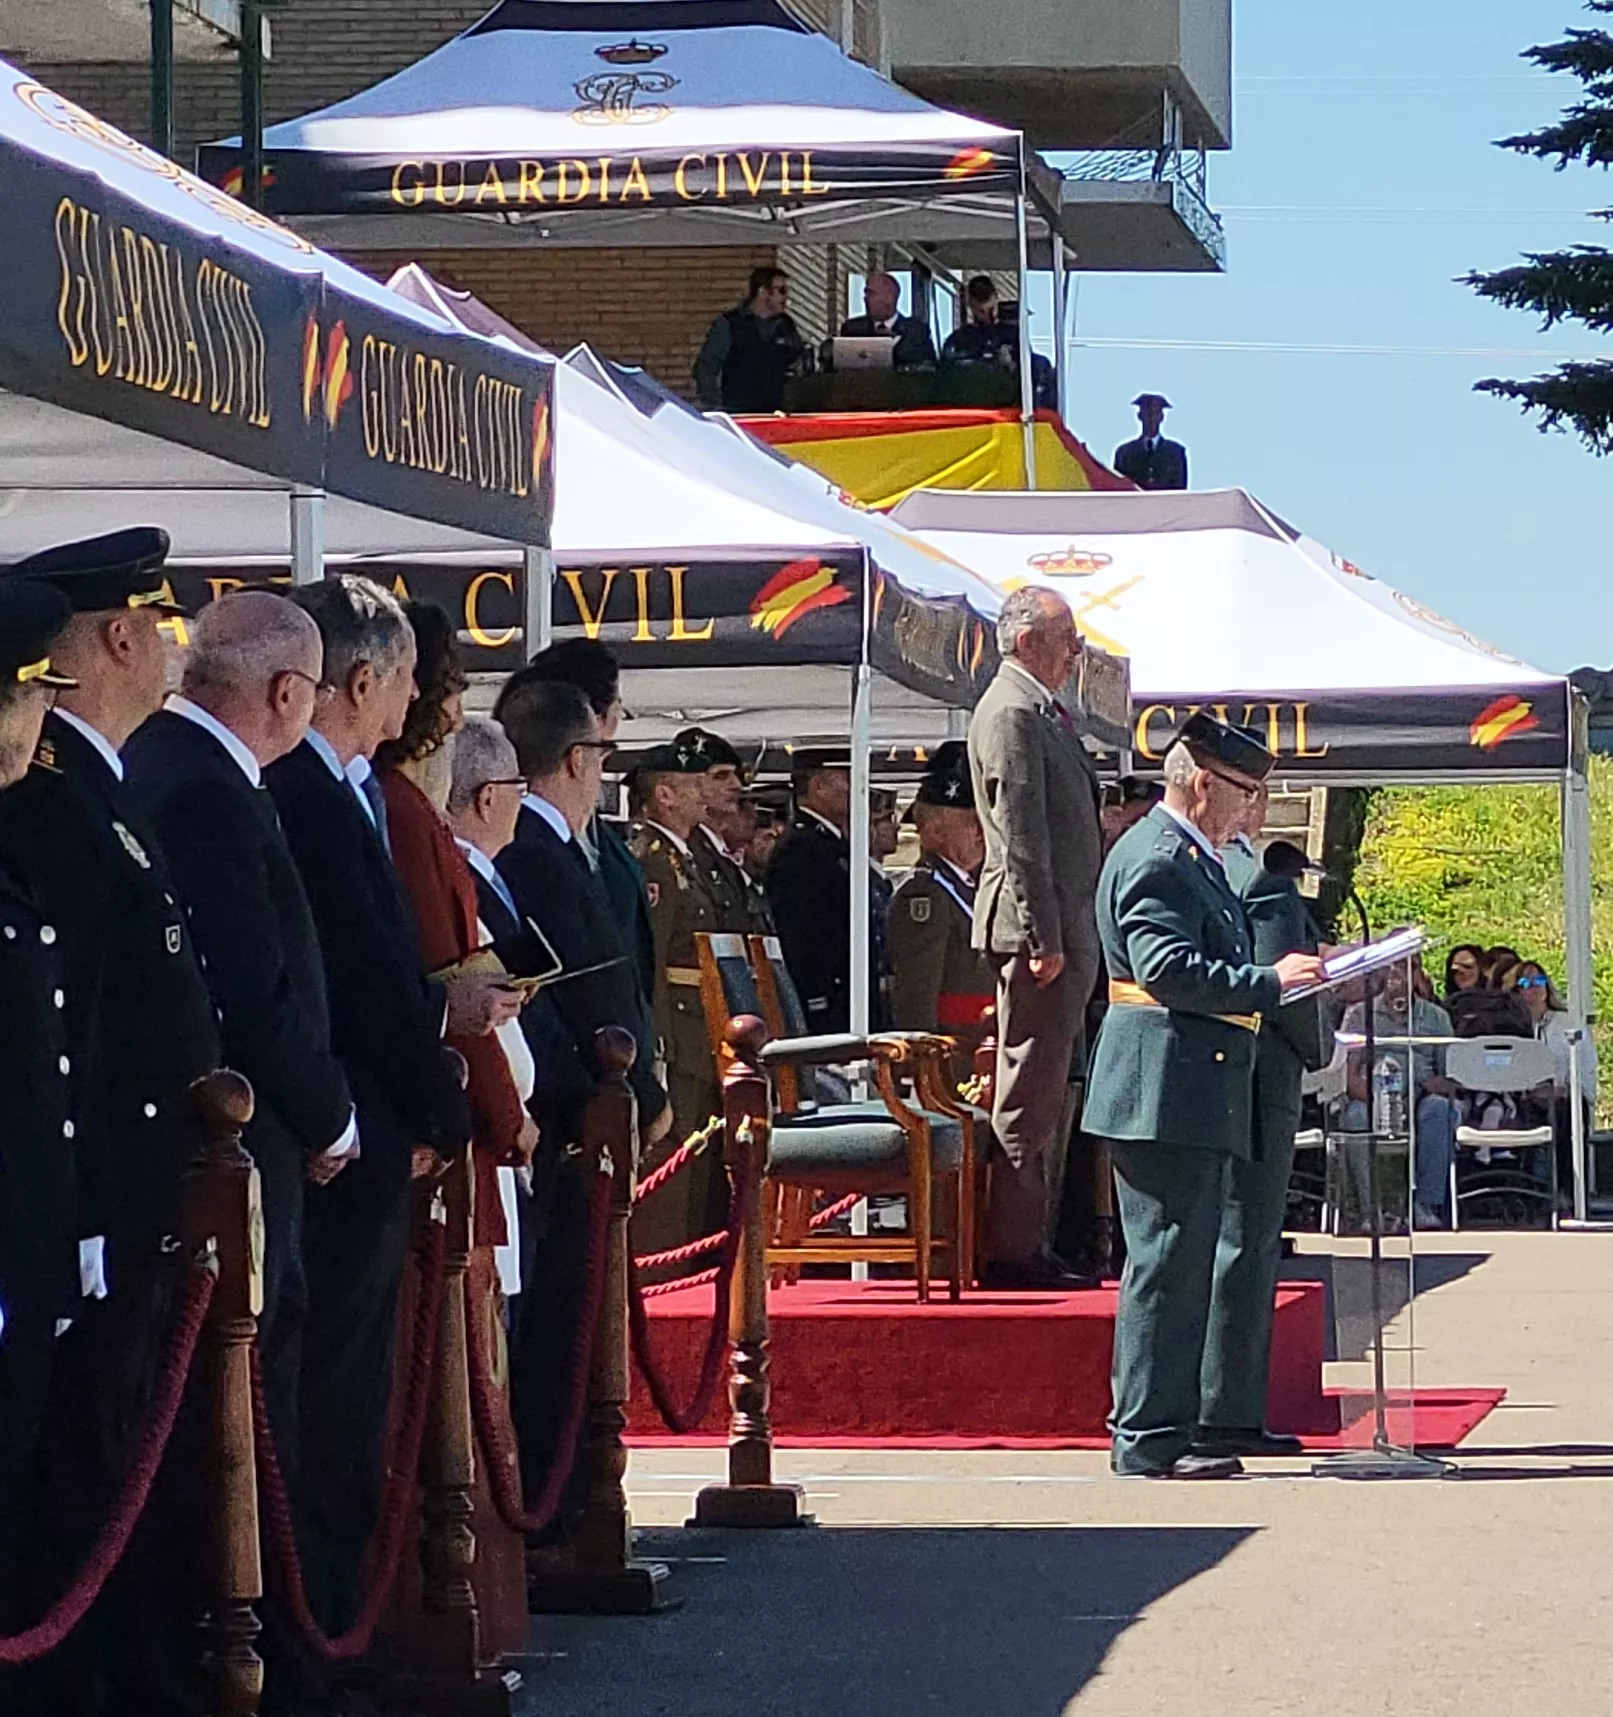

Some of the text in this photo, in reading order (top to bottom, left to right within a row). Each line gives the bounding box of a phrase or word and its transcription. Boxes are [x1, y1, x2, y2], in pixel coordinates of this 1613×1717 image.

[390, 150, 831, 207] GUARDIA CIVIL
[55, 197, 272, 429] GUARDIA CIVIL
[362, 334, 529, 497] GUARDIA CIVIL
[464, 566, 715, 648] CVIL
[1135, 702, 1330, 760] CIL
